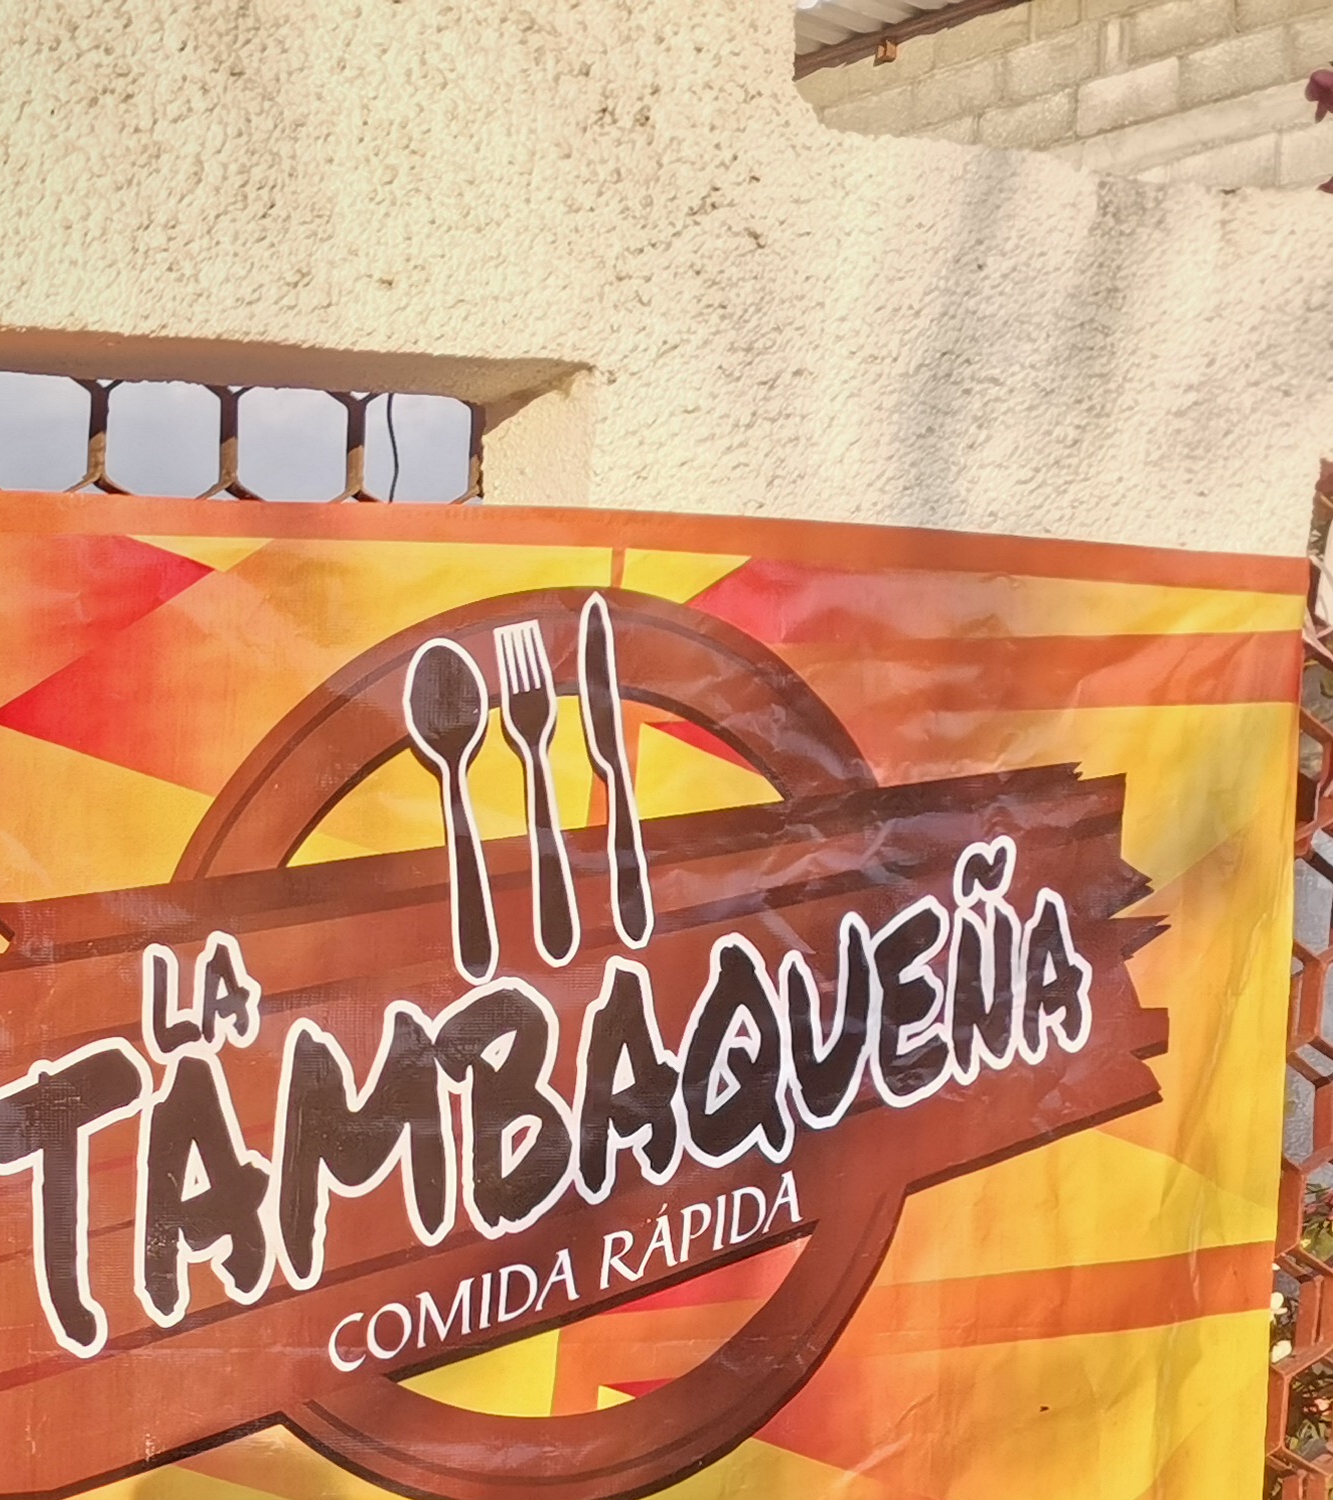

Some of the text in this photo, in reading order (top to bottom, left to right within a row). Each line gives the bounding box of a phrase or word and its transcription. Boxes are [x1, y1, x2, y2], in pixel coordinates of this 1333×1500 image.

[140, 931, 261, 1054] LA
[328, 1170, 805, 1373] COMIDA RÁPIDA
